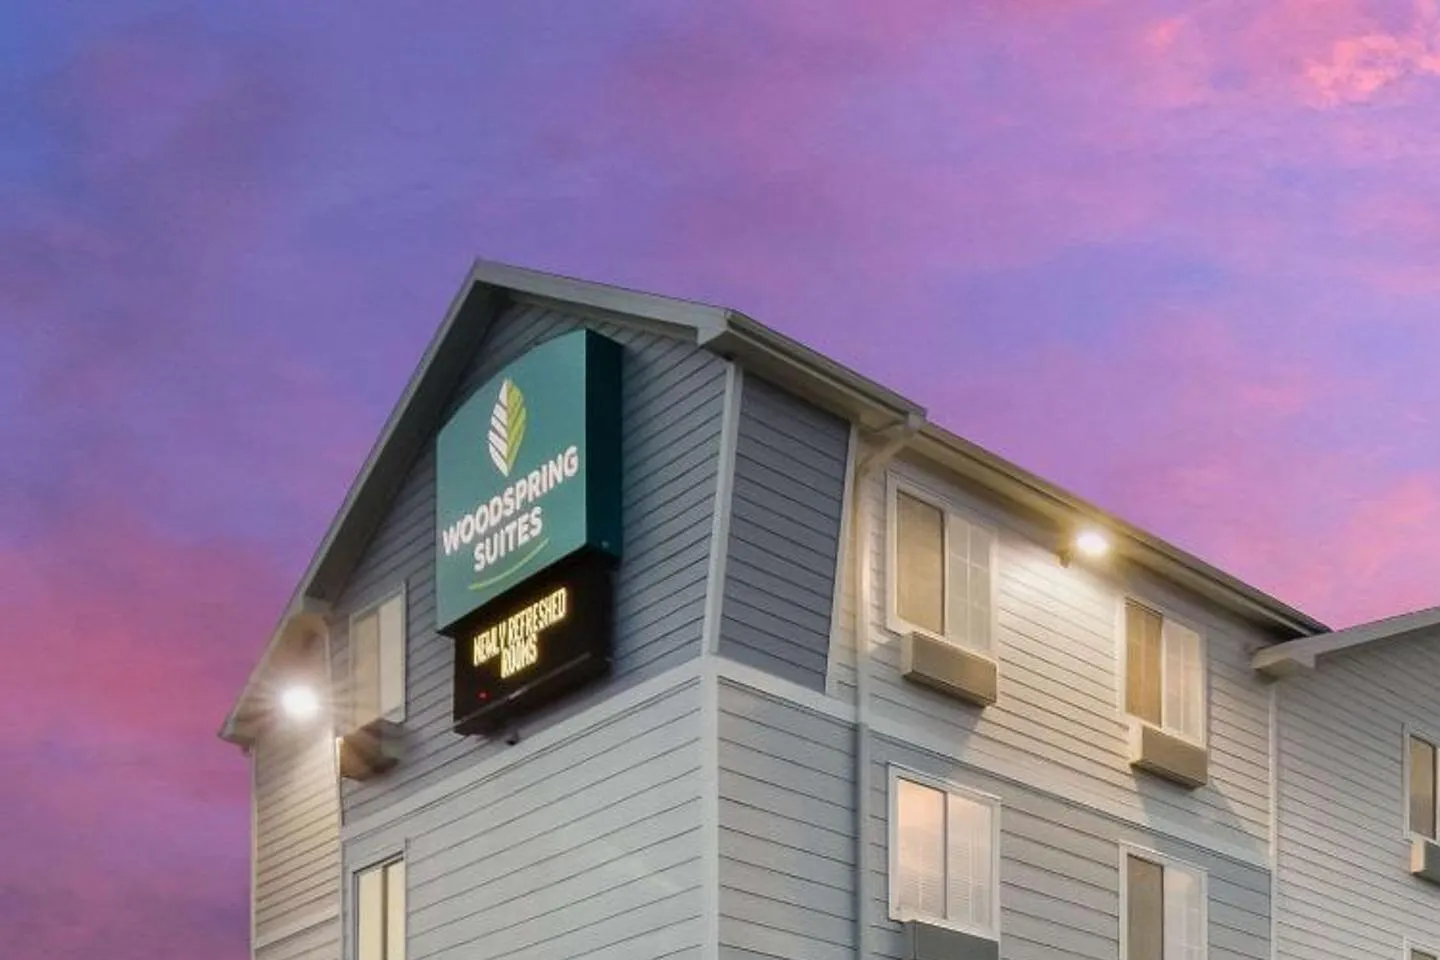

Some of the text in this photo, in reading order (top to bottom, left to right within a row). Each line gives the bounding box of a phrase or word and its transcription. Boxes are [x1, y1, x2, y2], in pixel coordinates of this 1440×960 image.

[442, 445, 579, 556] WOODSPRING
[473, 506, 543, 572] SUITES
[507, 587, 567, 648] REFRESHED
[501, 632, 539, 679] ROOMS
